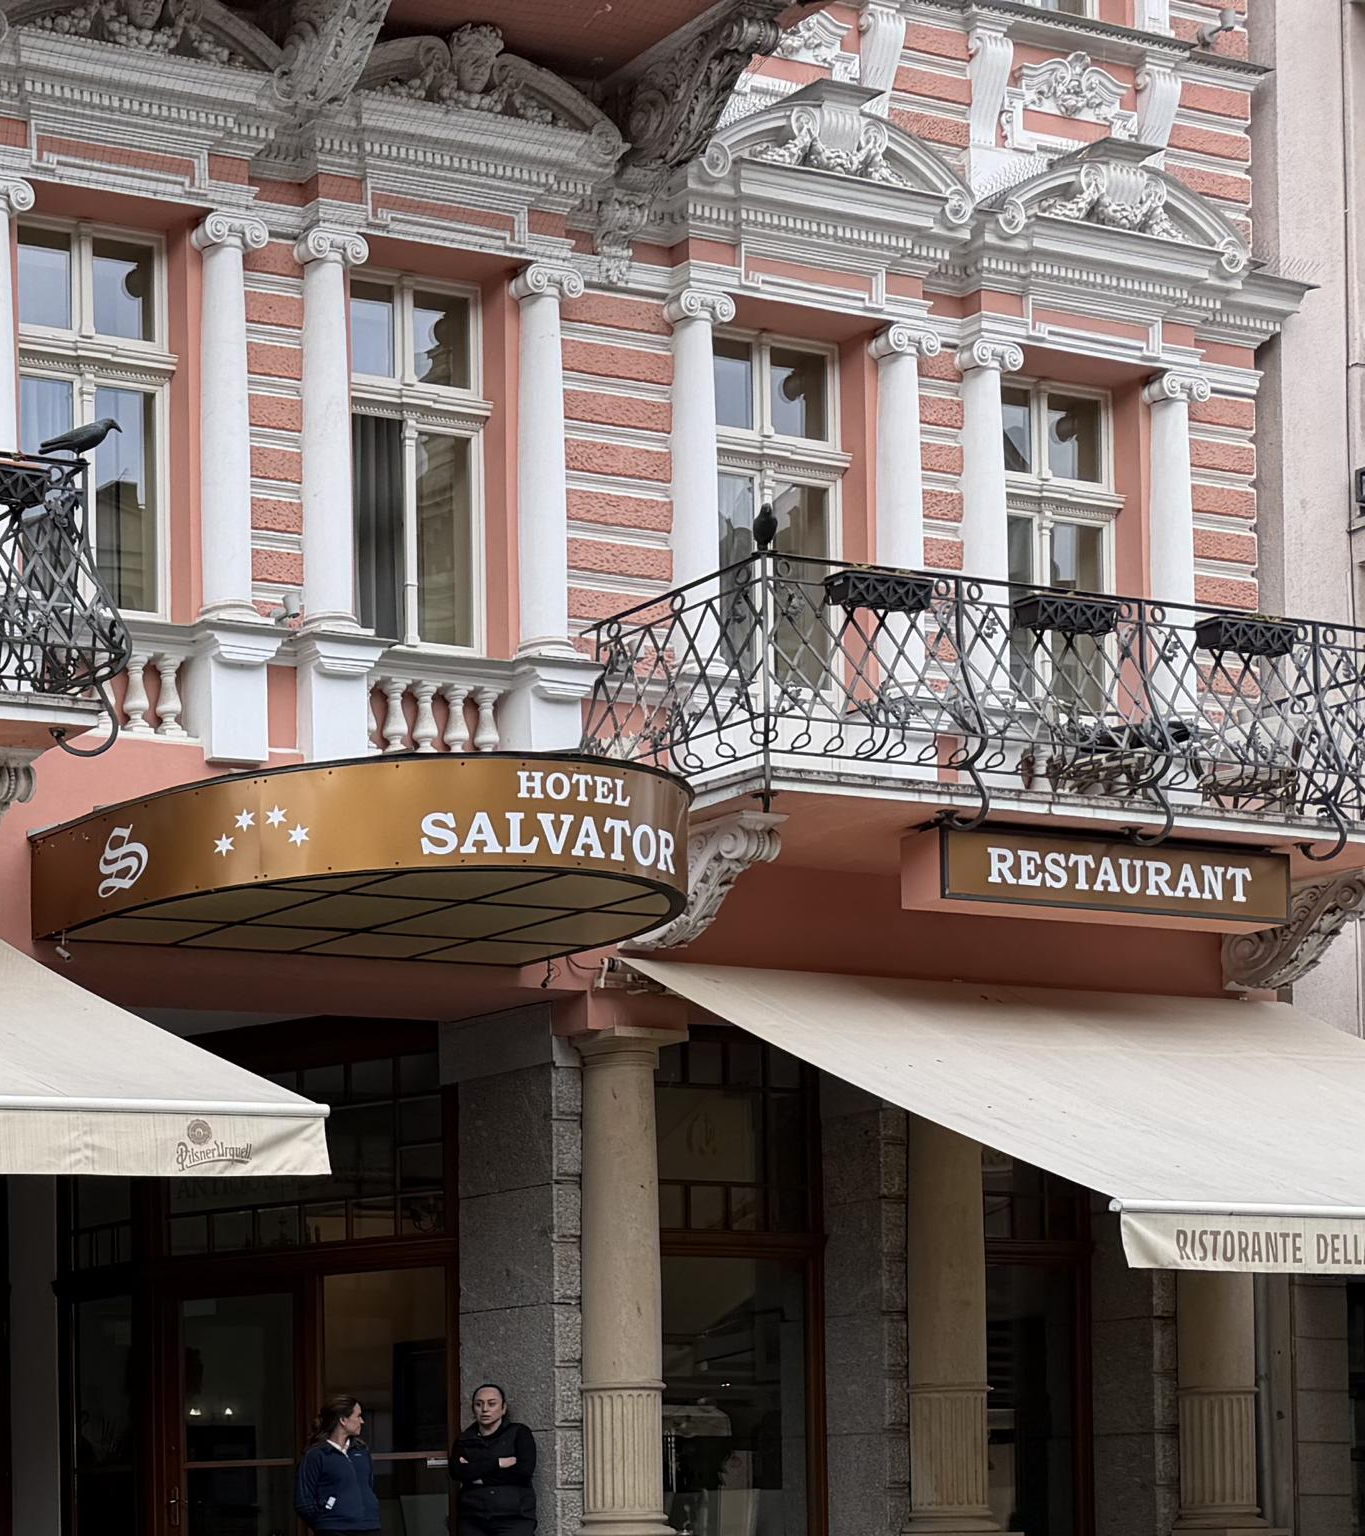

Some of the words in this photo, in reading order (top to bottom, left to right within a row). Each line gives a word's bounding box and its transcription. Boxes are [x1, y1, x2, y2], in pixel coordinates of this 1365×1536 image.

[516, 770, 631, 808] HOTEL
[420, 811, 677, 875] SALVATOR
[987, 846, 1252, 902] RESTAURANT
[176, 1141, 218, 1172] Pilsner
[214, 1140, 253, 1165] Urquell
[1175, 1229, 1303, 1264] RISTORANTE
[1316, 1233, 1365, 1265] DELL
